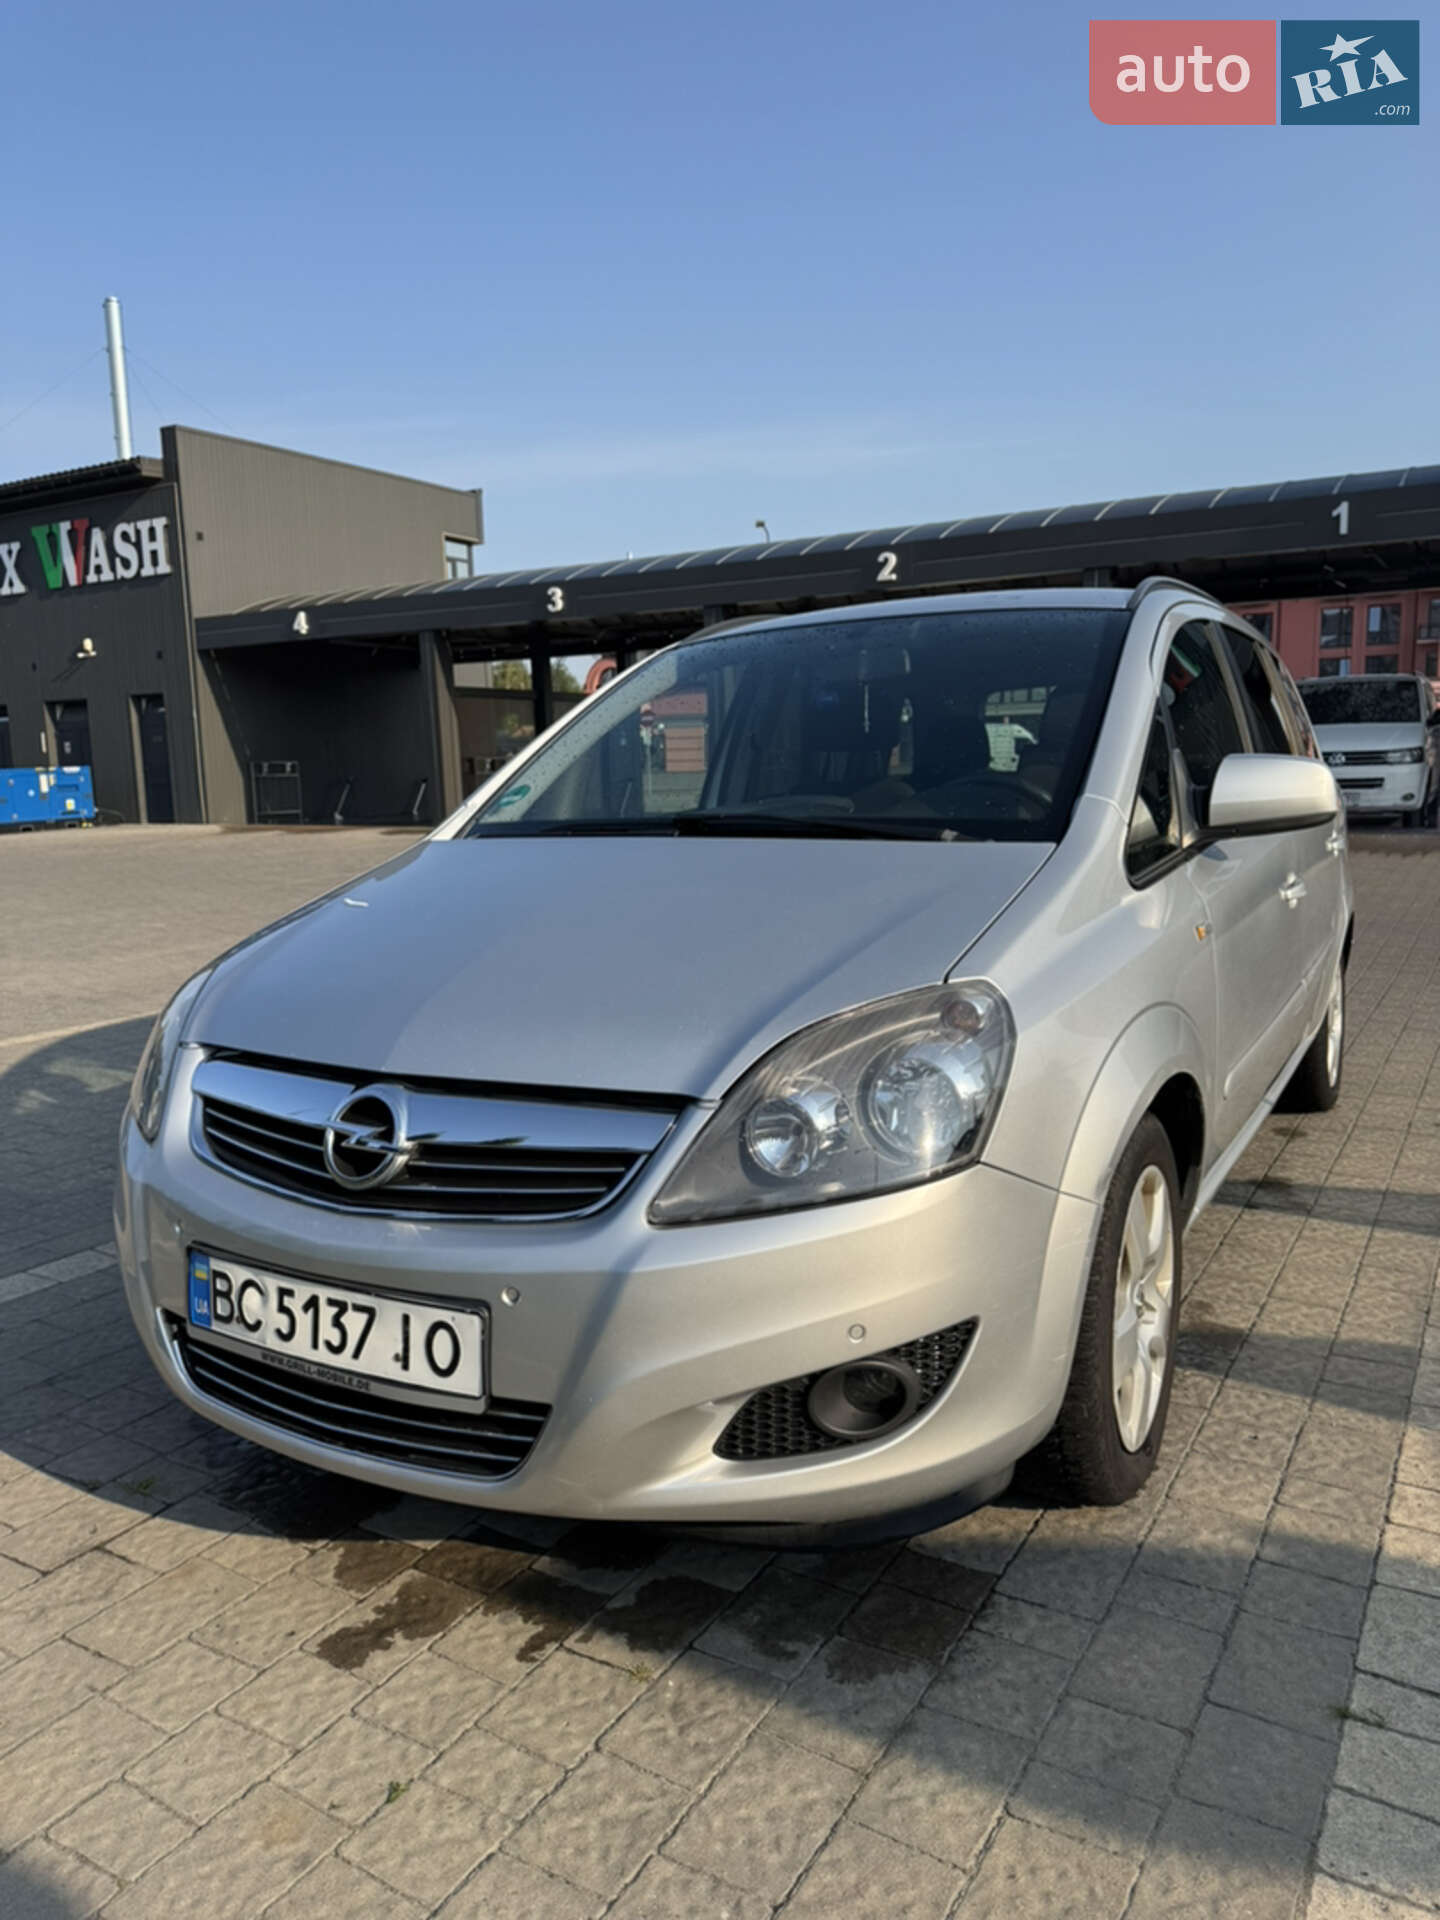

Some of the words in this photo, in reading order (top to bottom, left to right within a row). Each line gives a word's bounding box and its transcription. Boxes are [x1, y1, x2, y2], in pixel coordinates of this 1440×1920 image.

[1331, 500, 1349, 535] 1
[31, 516, 172, 590] WASH
[876, 551, 897, 581] 2
[546, 587, 564, 613] 3
[292, 610, 309, 634] 4
[212, 1269, 265, 1333] BC
[275, 1286, 376, 1360] 5137
